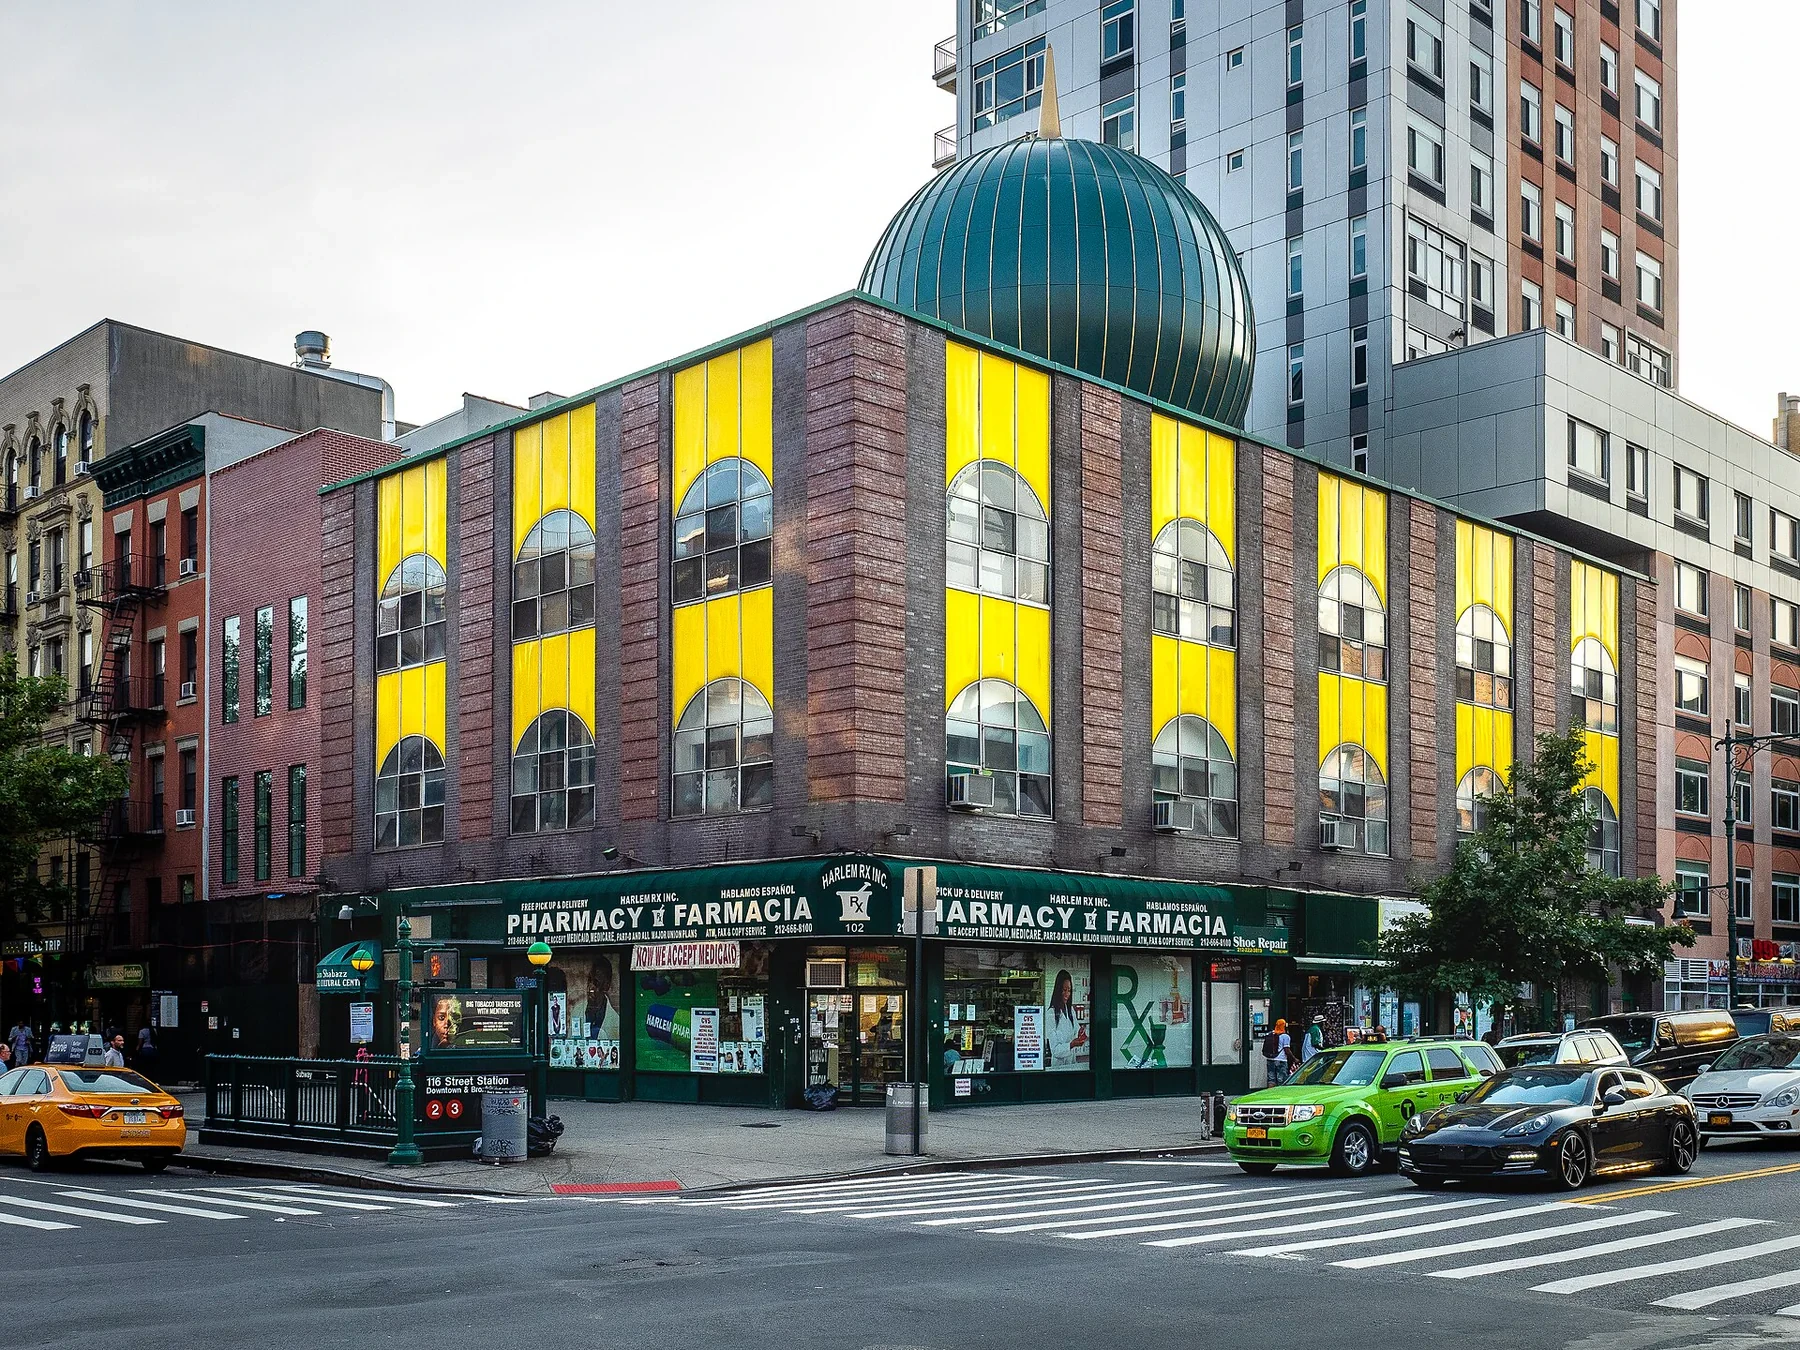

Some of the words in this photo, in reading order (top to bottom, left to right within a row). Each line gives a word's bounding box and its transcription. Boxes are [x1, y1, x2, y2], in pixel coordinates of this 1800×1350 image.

[822, 864, 858, 889] HARLEM
[872, 868, 888, 890] INC.
[720, 887, 760, 898] HABLAMOS
[762, 884, 796, 896] ESPAÑOL
[953, 888, 963, 898] UP
[964, 889, 970, 898] &
[970, 889, 1004, 900] DELIVERY
[620, 894, 650, 905] HARLEM
[663, 892, 678, 902] INC.
[1050, 894, 1081, 906] HARLEM
[1095, 897, 1110, 907] INC.
[521, 902, 534, 911] FREE
[535, 902, 548, 910] PICK
[549, 901, 556, 910] UP
[557, 901, 561, 909] &
[562, 899, 588, 909] DELIVERY
[674, 896, 812, 926] FARMACIA
[1146, 902, 1180, 911] HABLAMOS
[1181, 902, 1208, 912] ESPAÑOL
[902, 896, 1075, 928] HARMACY
[508, 906, 644, 934] PHARMACY
[1106, 910, 1227, 936] FARMACIA
[683, 929, 697, 938] PLANS
[717, 928, 726, 937] FAX
[731, 927, 745, 936] COPY
[745, 926, 766, 936] SERVICE
[845, 923, 864, 933] 102
[958, 928, 979, 937] ACCEPT
[1082, 933, 1099, 943] MAJOR
[1116, 936, 1131, 944] PLANS
[1175, 937, 1194, 946] SERVICE
[45, 940, 61, 950] TRIP
[1233, 936, 1255, 948] Shoe
[1258, 937, 1287, 950] Repair
[636, 946, 654, 967] NOW
[655, 945, 667, 965] WE
[667, 944, 697, 965] ACCEPT
[699, 943, 736, 965] MEDICAID
[323, 969, 348, 978] Shabazz
[646, 1014, 672, 1032] HARLEM
[672, 1023, 690, 1038] PHAR
[296, 1069, 312, 1079] Subway
[426, 1077, 441, 1086] 116
[445, 1076, 473, 1086] Street
[477, 1076, 508, 1085] Station
[431, 1104, 439, 1115] 2
[451, 1103, 459, 1114] 3
